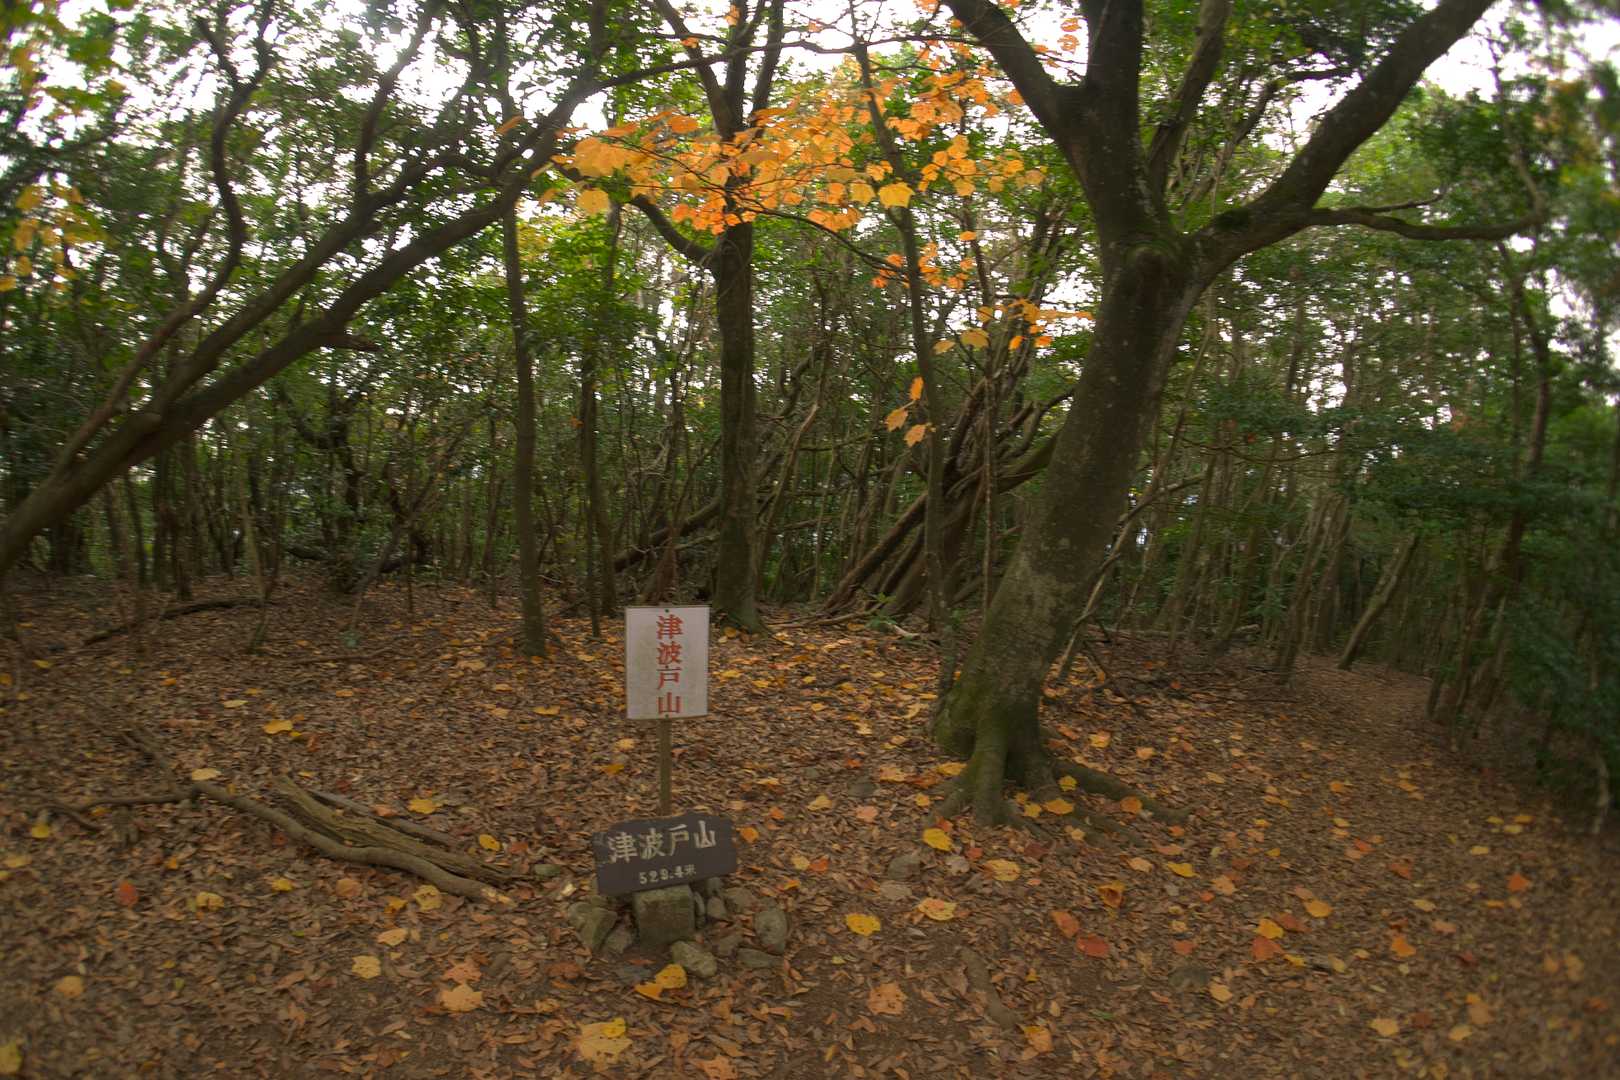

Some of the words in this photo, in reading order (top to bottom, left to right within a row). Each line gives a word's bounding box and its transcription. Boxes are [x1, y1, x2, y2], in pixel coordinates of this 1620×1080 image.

[656, 613, 683, 714] 津波戸山
[608, 820, 716, 862] 津波戸山
